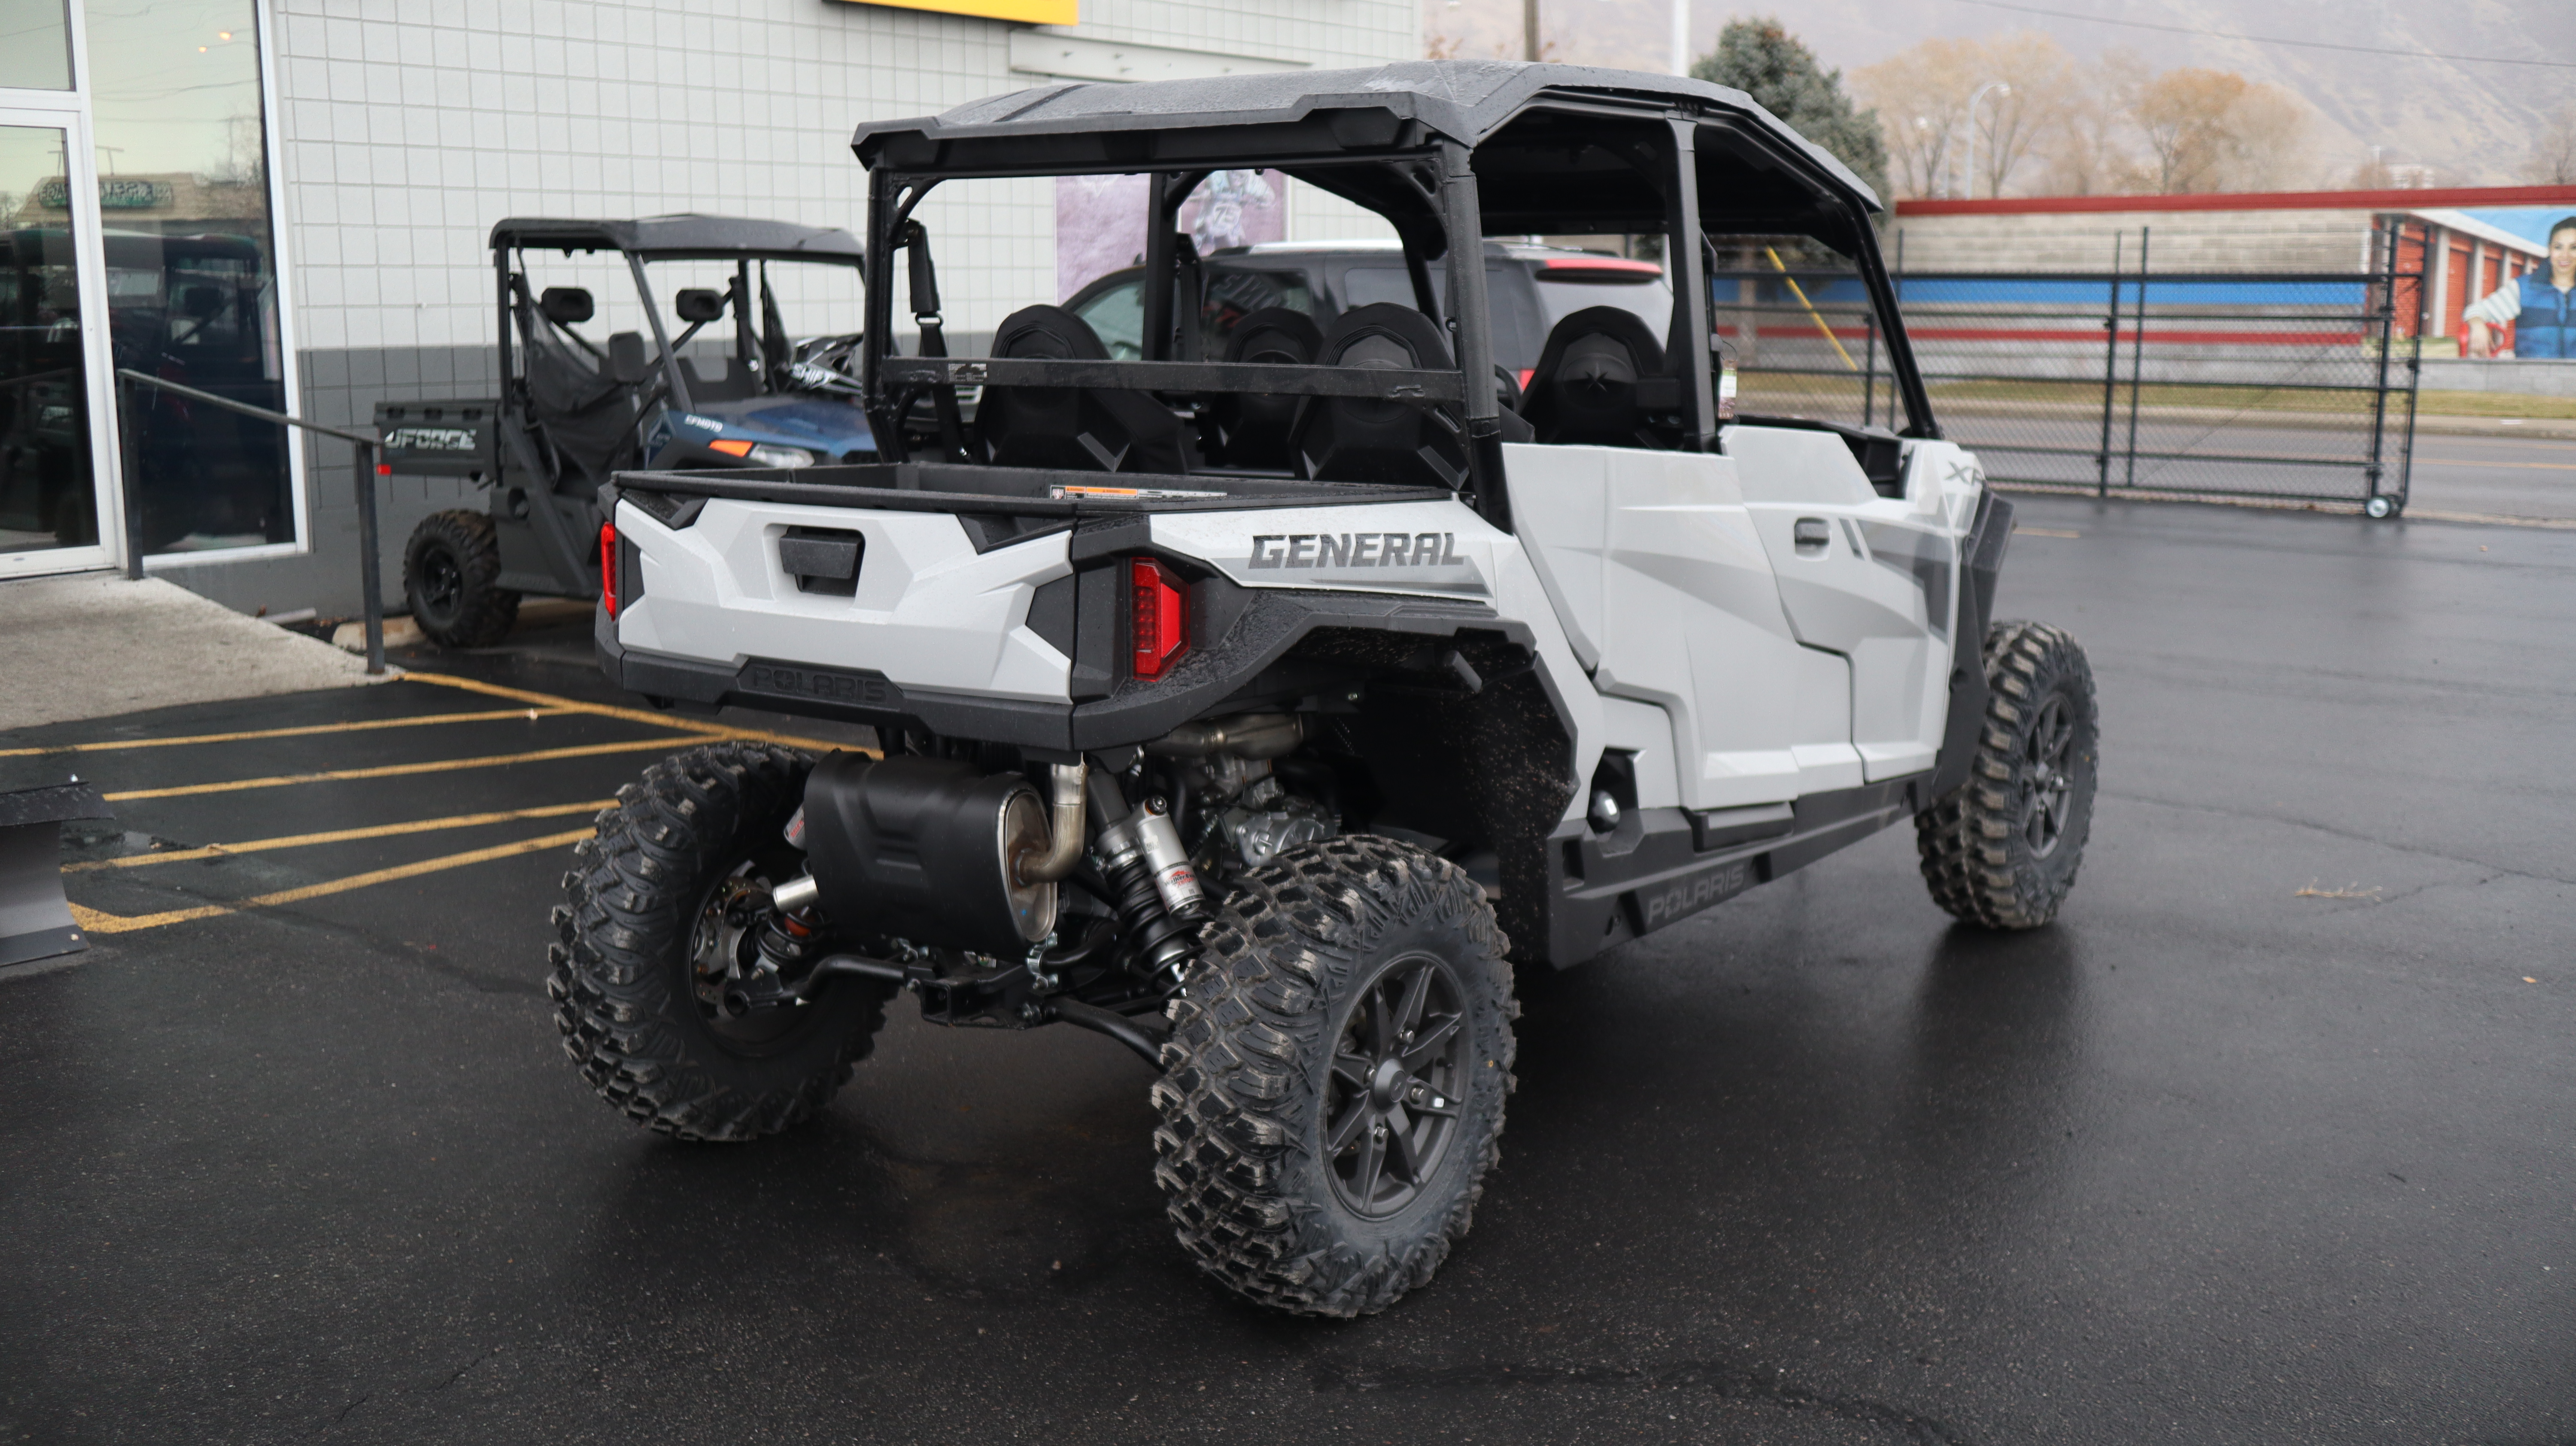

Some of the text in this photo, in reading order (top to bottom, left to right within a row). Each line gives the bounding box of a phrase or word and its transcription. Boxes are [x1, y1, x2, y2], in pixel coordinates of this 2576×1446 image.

[1249, 532, 1464, 569] GENERAL
[753, 666, 887, 703] POLARIS
[1165, 875, 1185, 886] Walker
[1648, 865, 1744, 924] POLARIS
